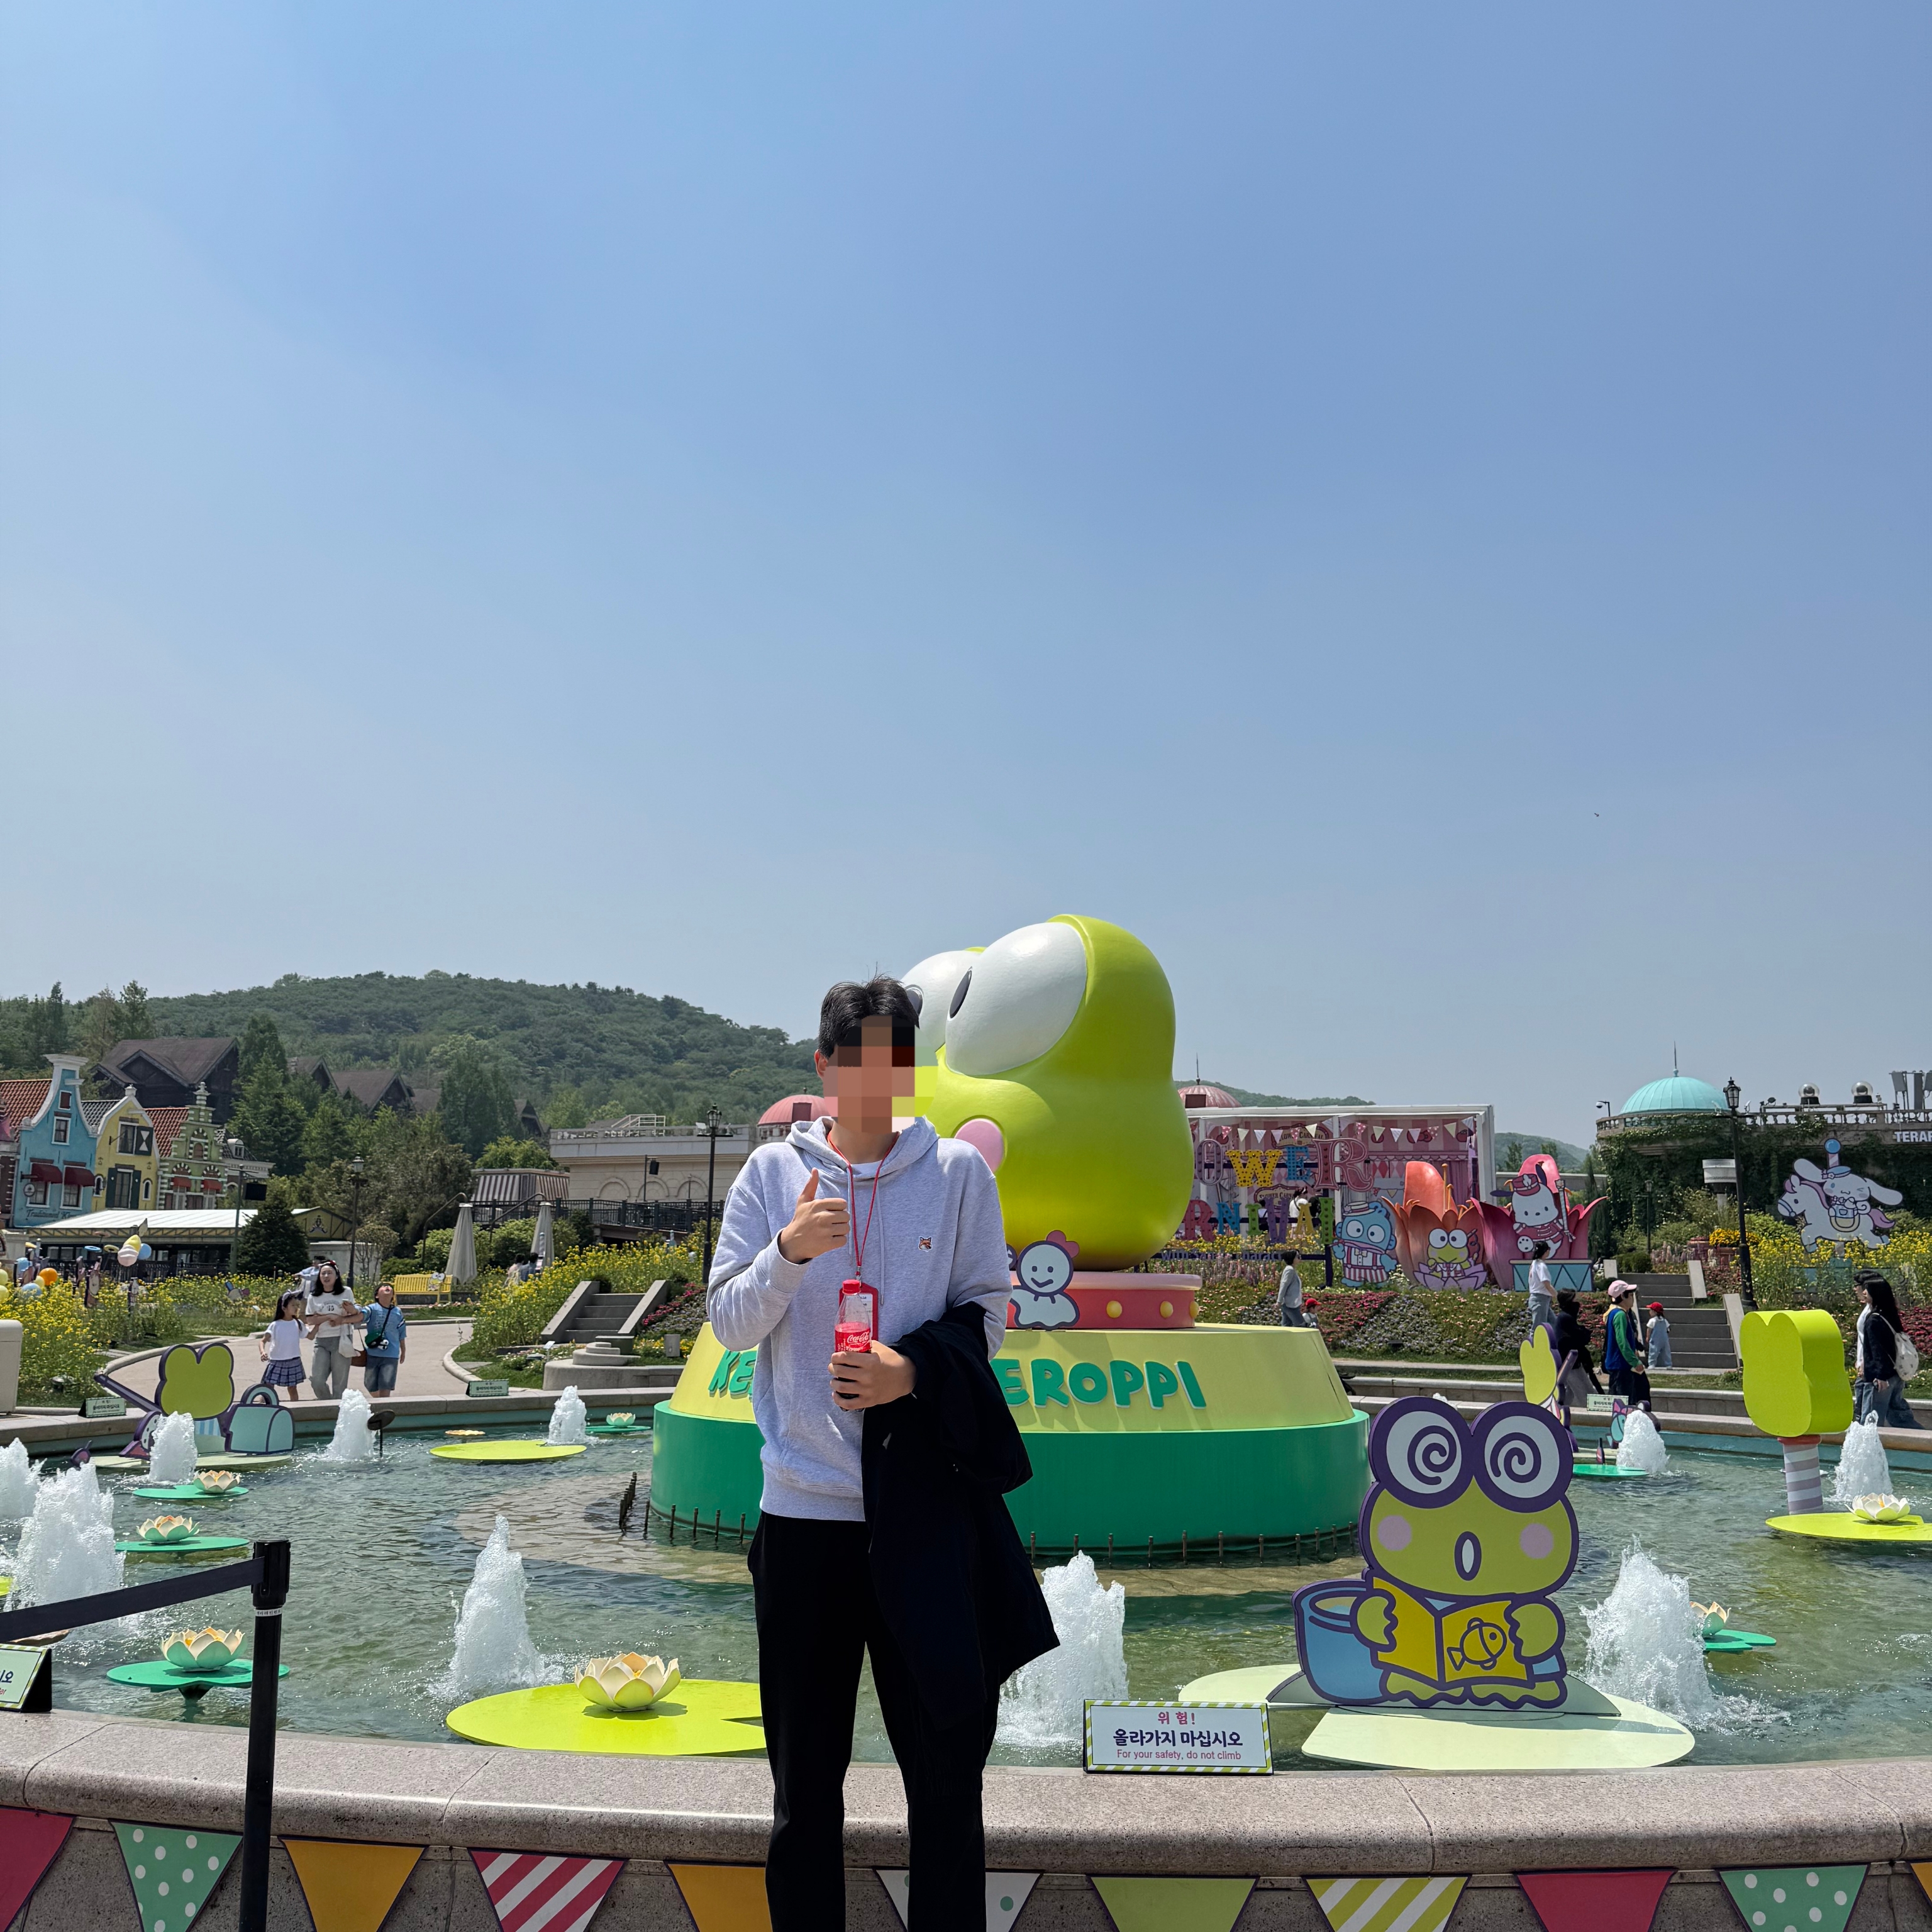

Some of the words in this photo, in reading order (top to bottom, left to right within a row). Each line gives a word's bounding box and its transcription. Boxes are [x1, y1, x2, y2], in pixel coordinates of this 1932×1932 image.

[708, 1349, 757, 1395] KE
[1158, 1711, 1170, 1724] 위
[1175, 1711, 1195, 1725] 험!
[1113, 1728, 1176, 1746] 올라가지
[1180, 1730, 1243, 1748] 마십시오
[1117, 1749, 1131, 1758] For
[1133, 1751, 1153, 1760] your
[1155, 1750, 1184, 1760] safety,
[1187, 1750, 1198, 1759] do
[1201, 1751, 1215, 1759] not
[1217, 1751, 1241, 1760] climb
